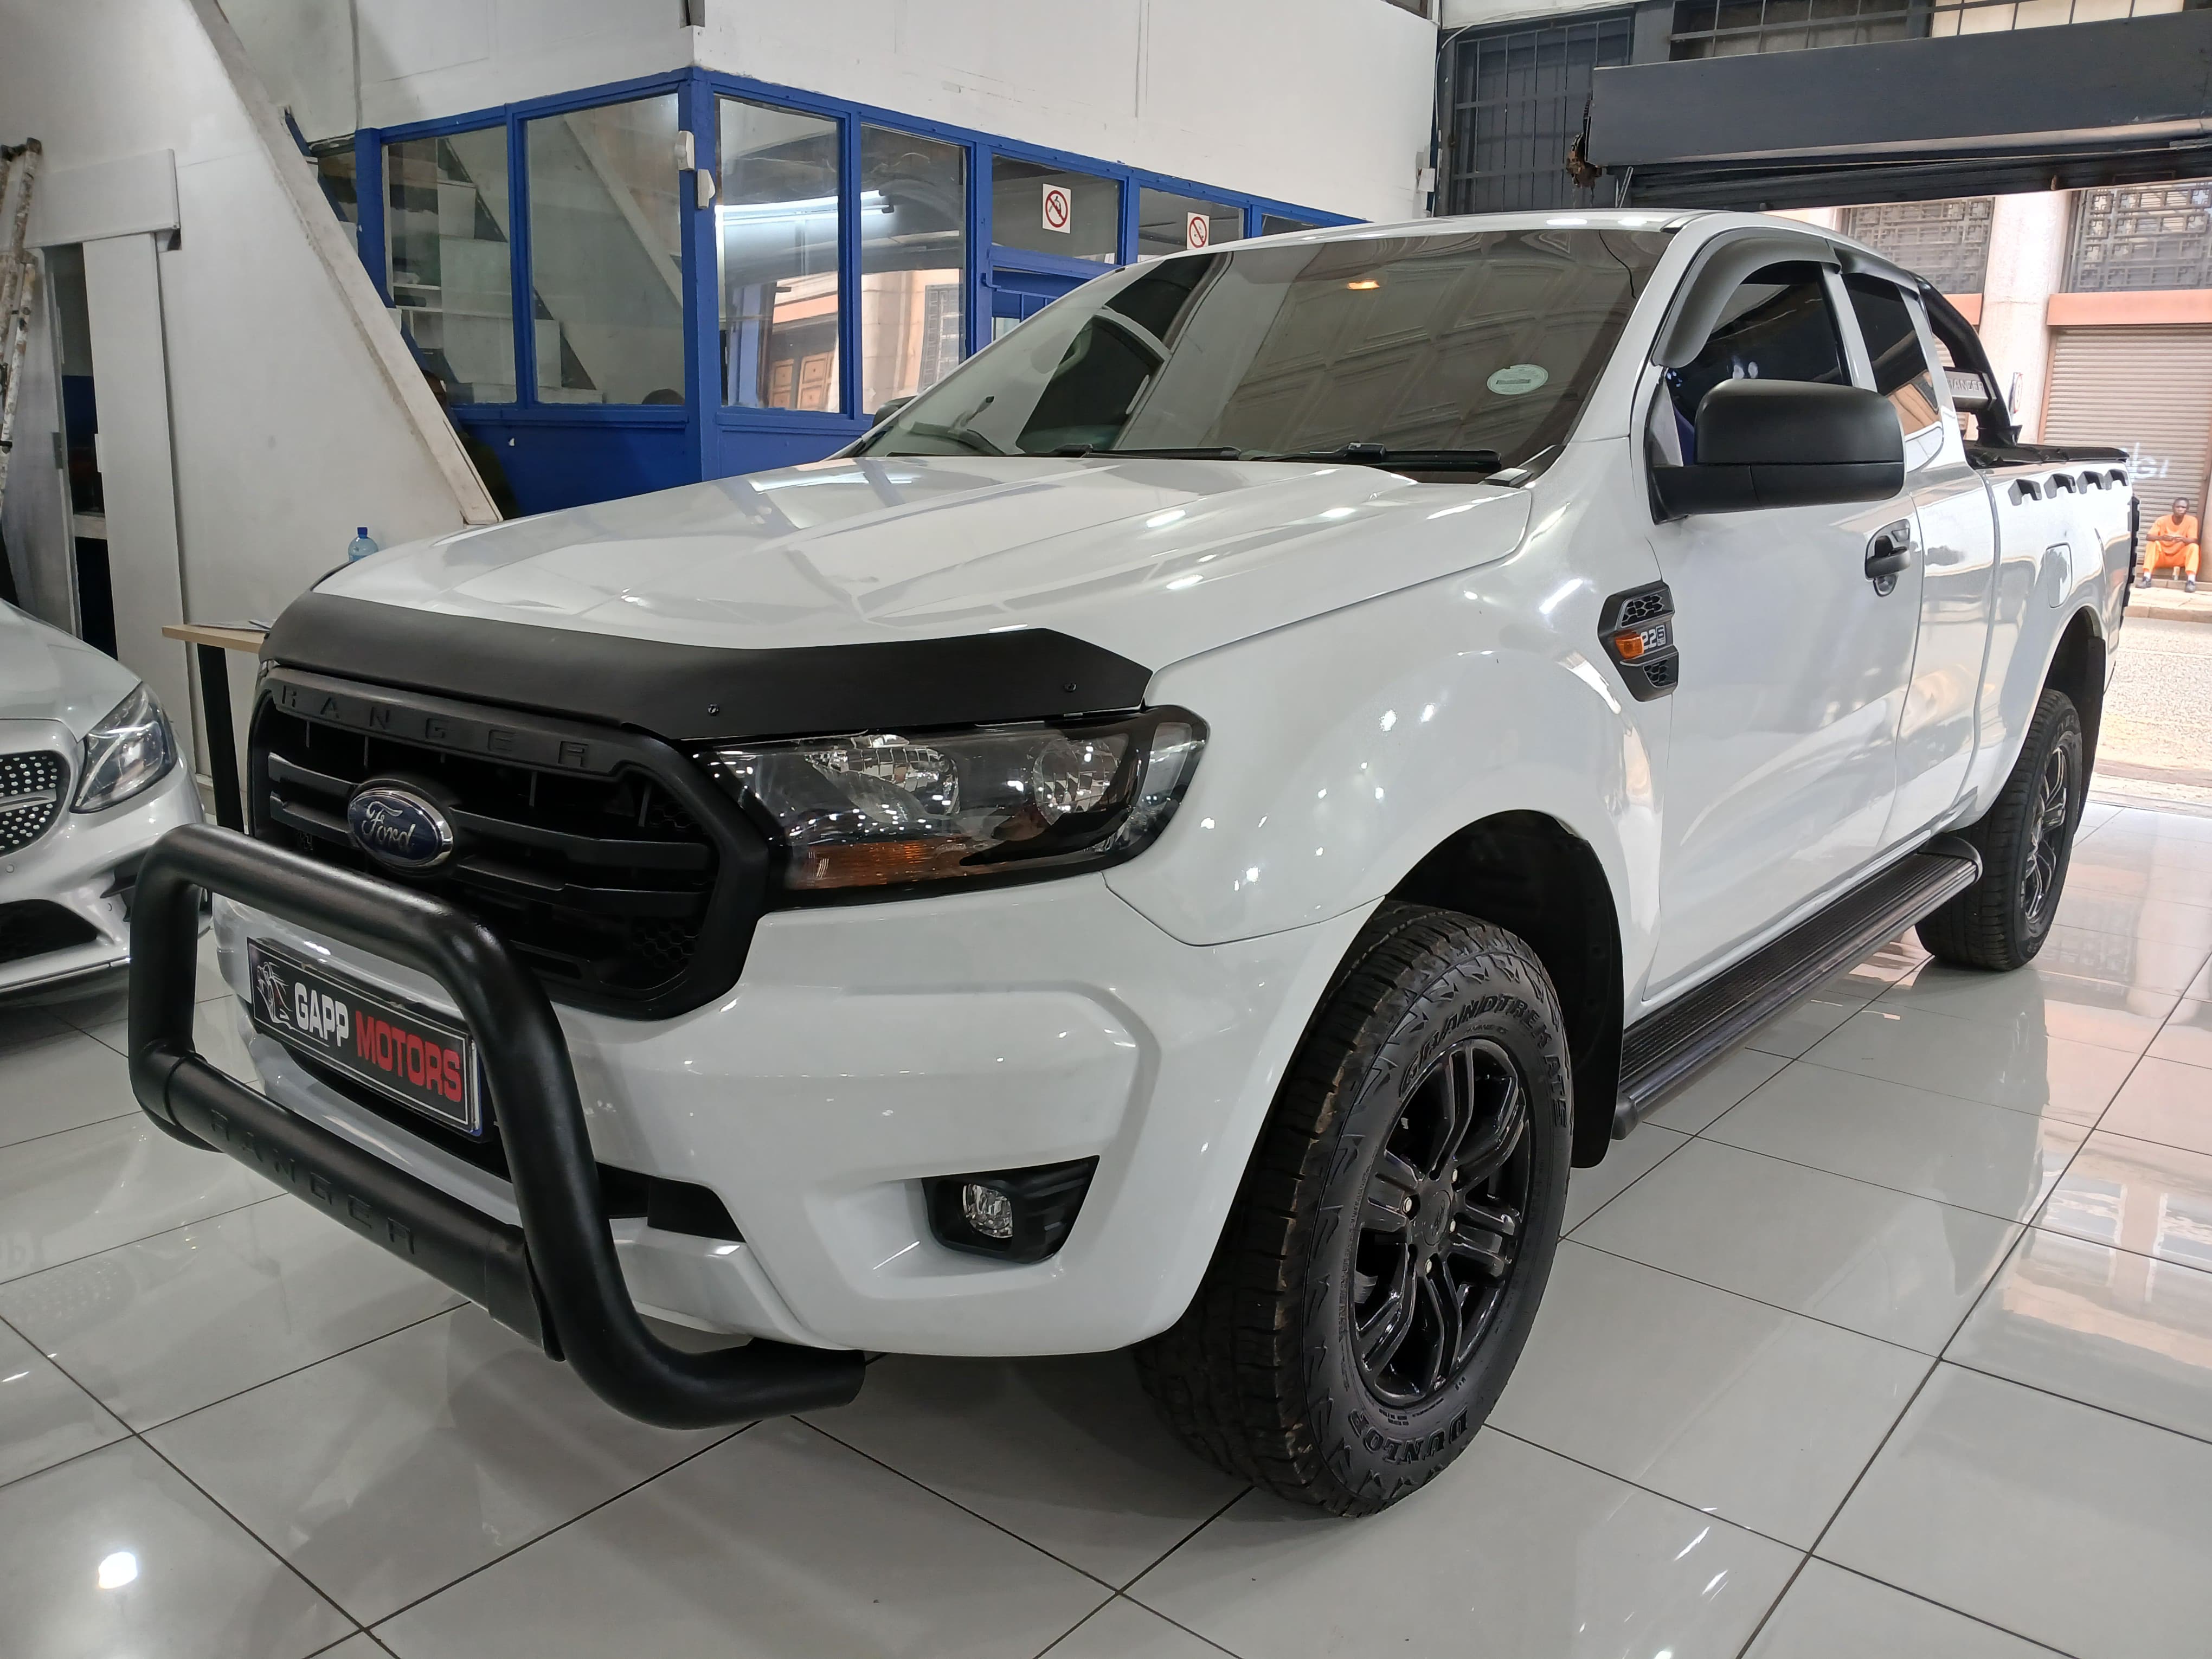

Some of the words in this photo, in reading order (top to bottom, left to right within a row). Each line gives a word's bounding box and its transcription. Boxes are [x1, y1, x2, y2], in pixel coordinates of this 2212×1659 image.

[281, 684, 590, 767] RANGER
[364, 800, 417, 853] Ford
[294, 981, 349, 1047] GAPP
[355, 1010, 462, 1103] MOTORS
[1399, 994, 1553, 1097] GRANDTREK
[210, 1108, 415, 1255] RANGER
[1347, 1408, 1469, 1464] DUNLOP
